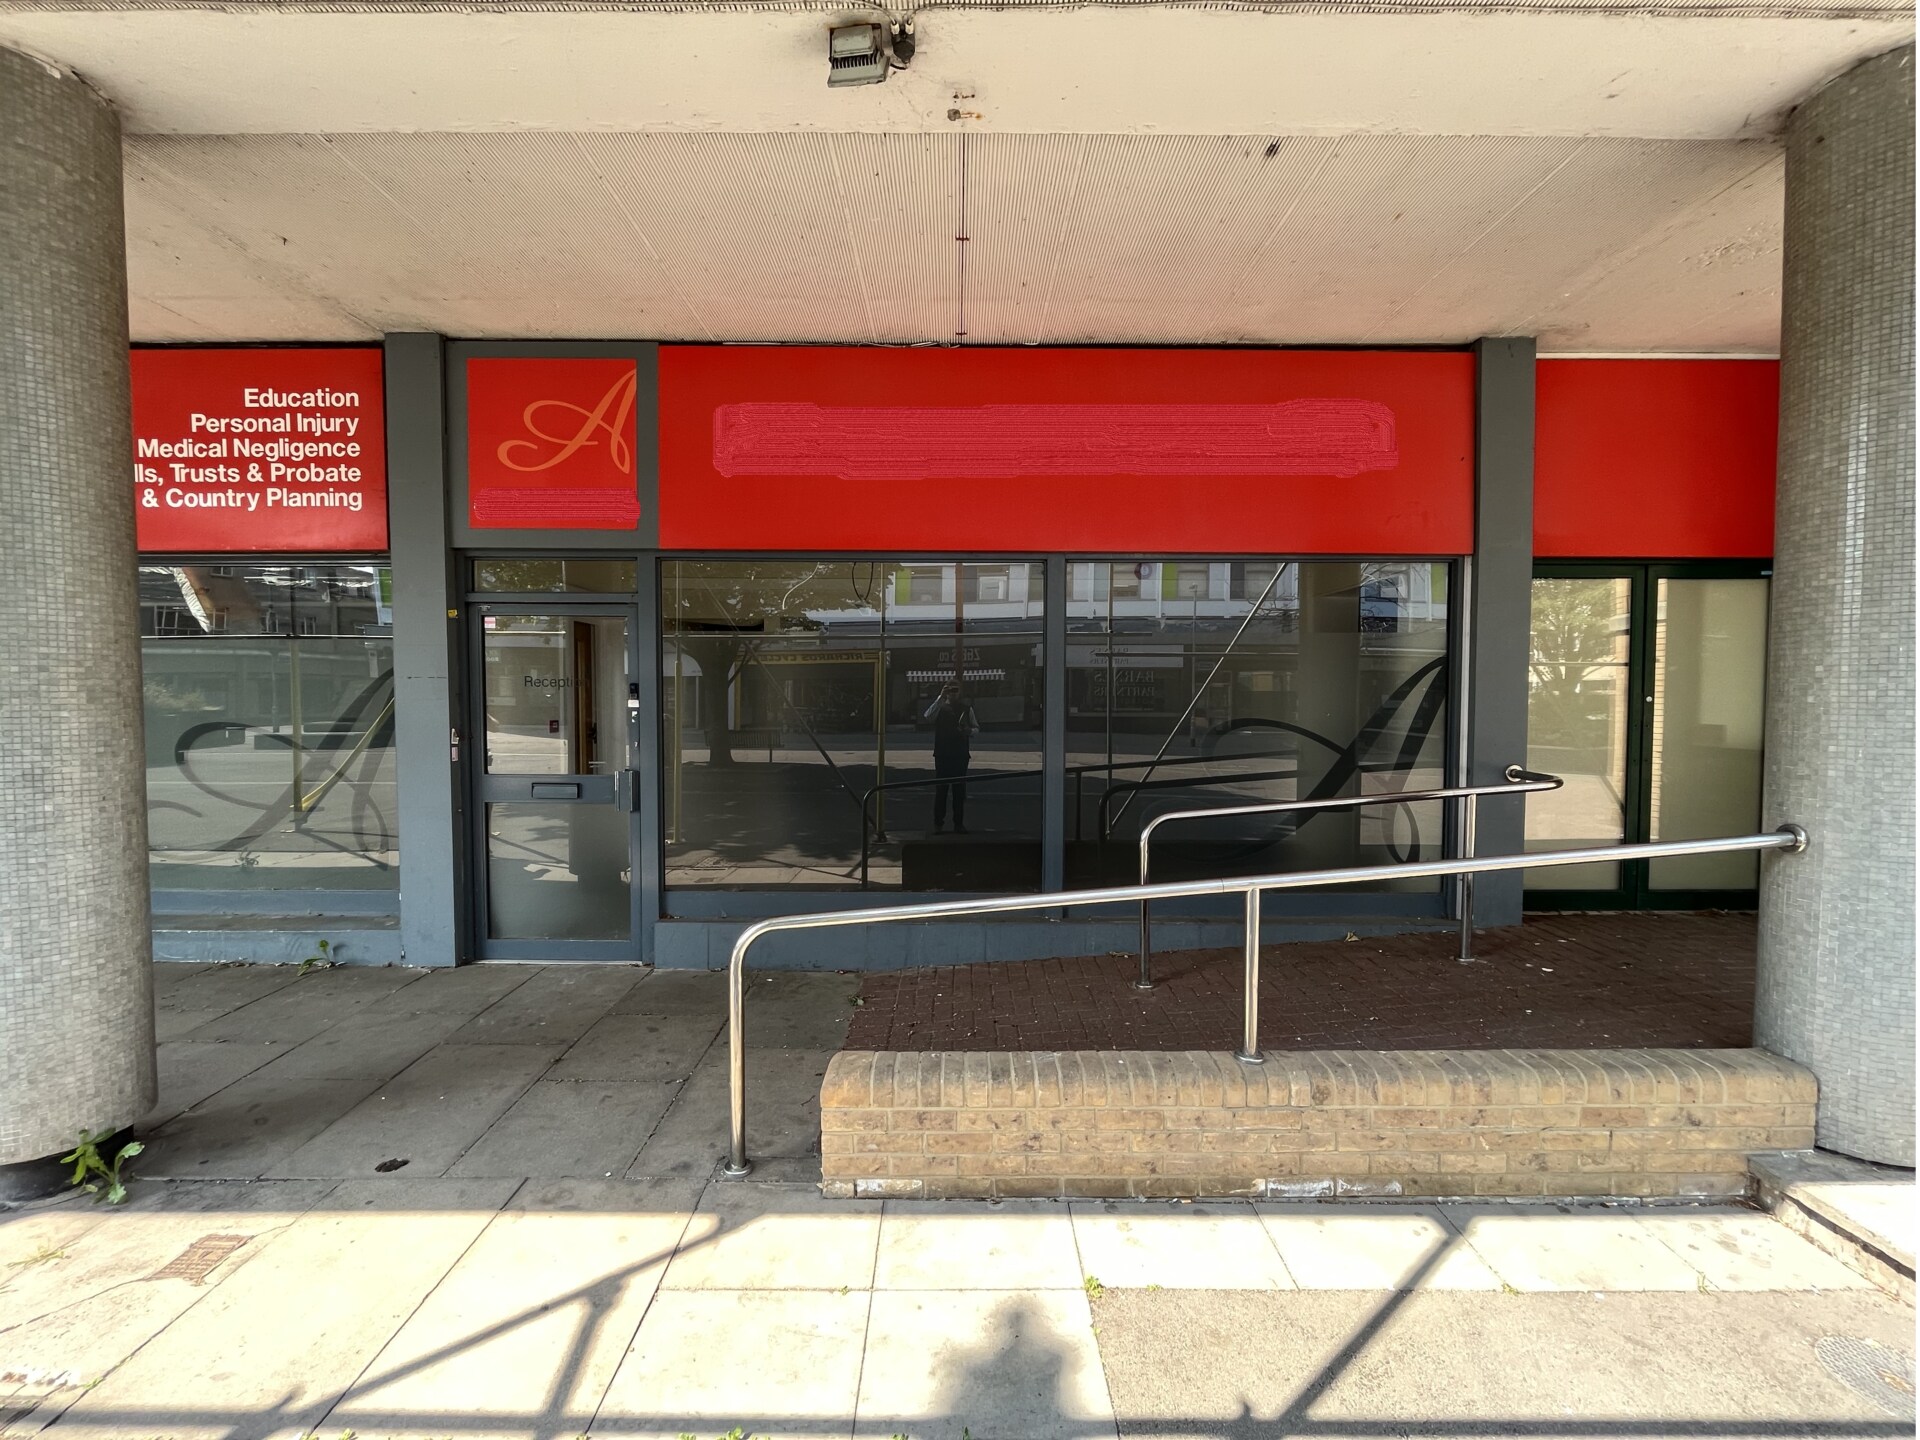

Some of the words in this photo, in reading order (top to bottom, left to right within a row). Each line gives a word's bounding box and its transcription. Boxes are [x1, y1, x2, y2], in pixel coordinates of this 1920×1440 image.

[244, 388, 359, 407] Education
[190, 413, 290, 432] Personal
[296, 413, 359, 436] Injury
[497, 368, 637, 474] A
[137, 438, 227, 458] Medical
[233, 438, 361, 461] Negligence
[133, 463, 163, 486] lls,
[168, 463, 240, 483] Trusts
[246, 463, 263, 483] &
[270, 463, 361, 483] Probate
[141, 488, 159, 508] &
[165, 487, 260, 511] Country
[266, 487, 362, 511] Planning
